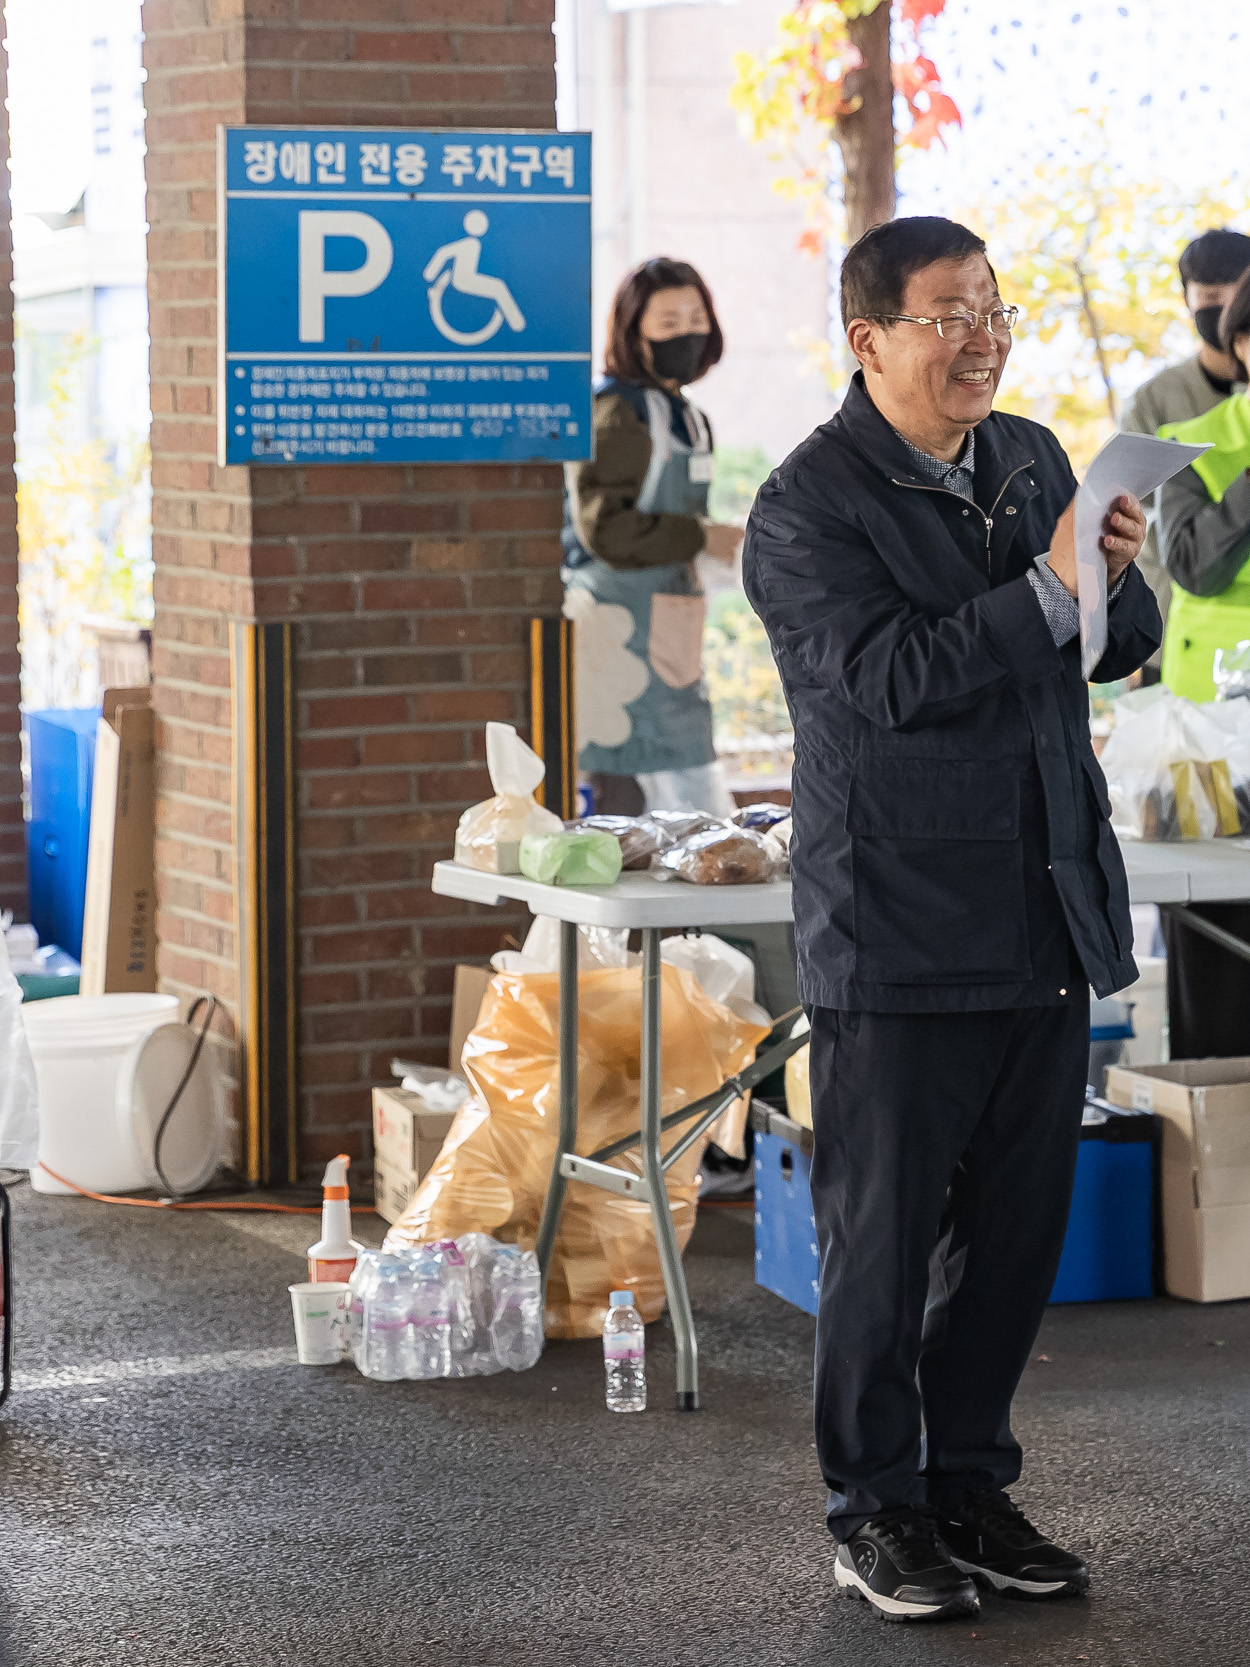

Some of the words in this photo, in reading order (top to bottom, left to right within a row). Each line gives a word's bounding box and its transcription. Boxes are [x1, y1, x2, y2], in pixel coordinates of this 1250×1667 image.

[244, 141, 346, 184] 장애인
[360, 143, 427, 185] 전용
[441, 145, 575, 188] 주차구역
[298, 210, 393, 343] P
